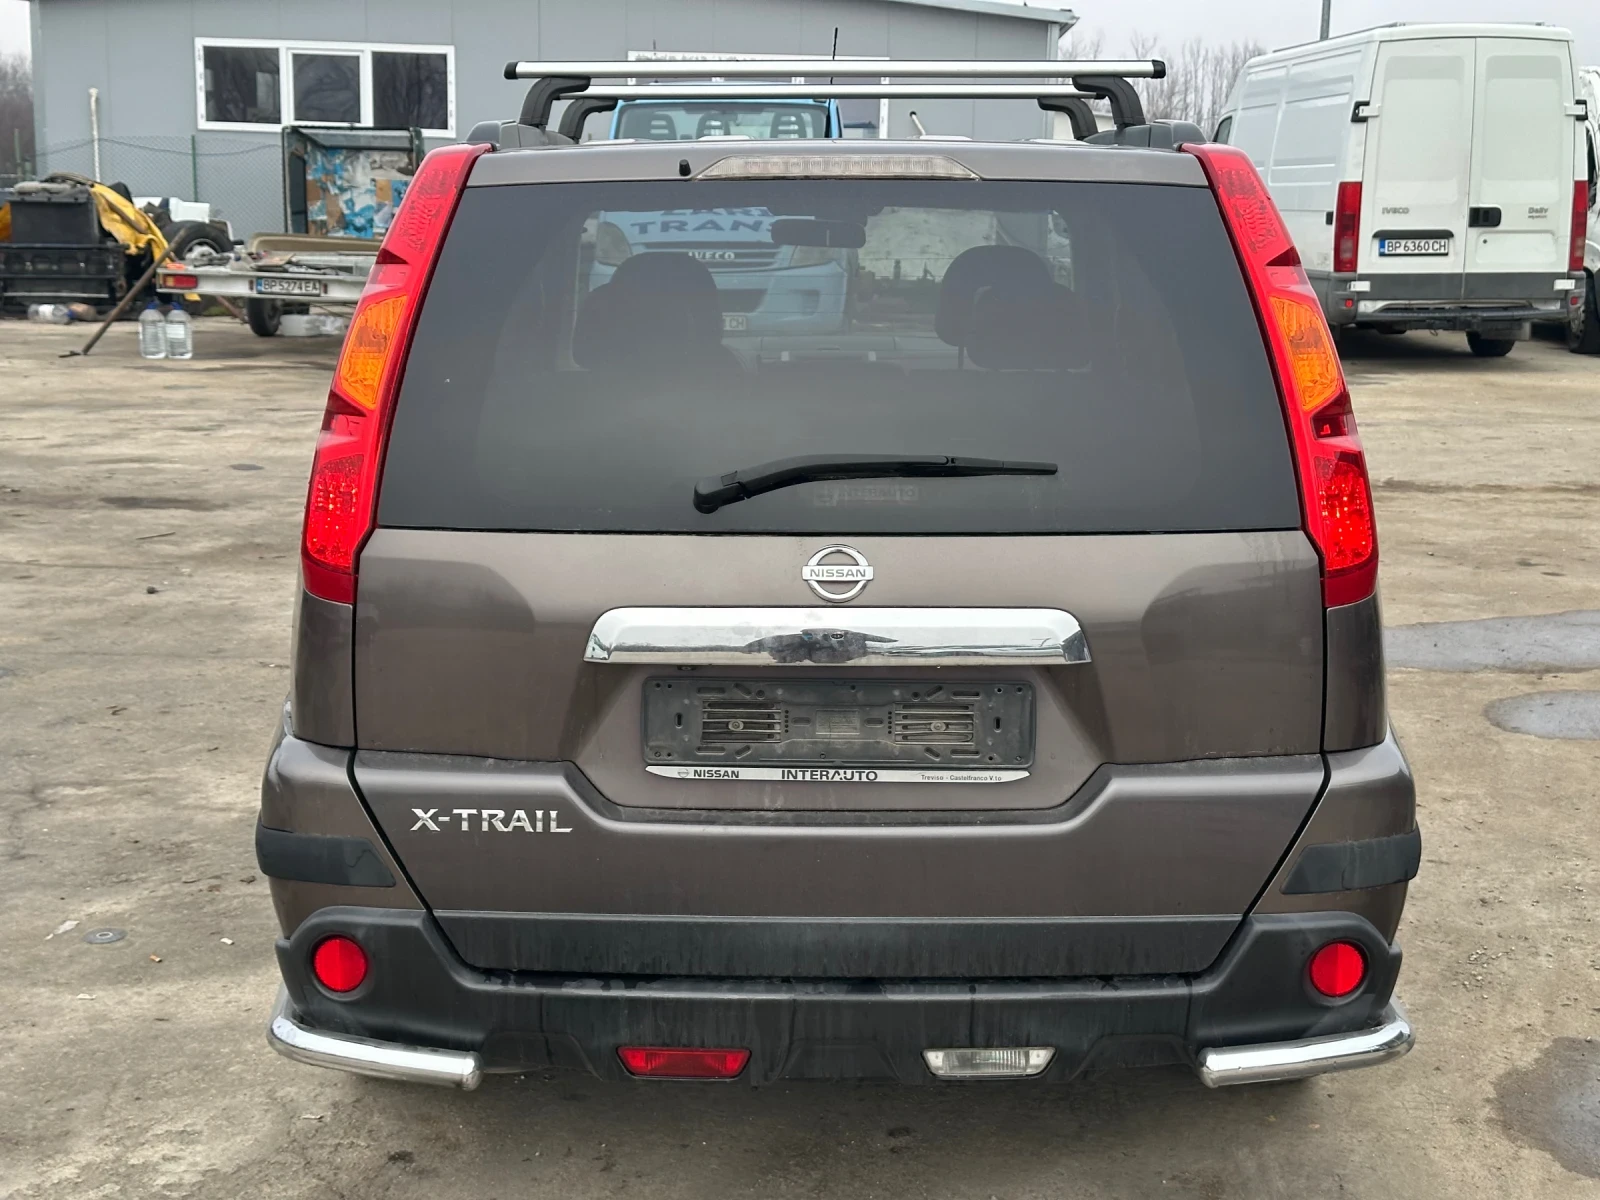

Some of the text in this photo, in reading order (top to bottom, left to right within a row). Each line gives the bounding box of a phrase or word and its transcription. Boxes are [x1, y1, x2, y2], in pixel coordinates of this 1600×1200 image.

[1382, 207, 1410, 215] IVECO
[1527, 206, 1549, 215] Daily
[630, 219, 771, 235] TRAN
[1387, 241, 1446, 252] BP 6360 CH
[263, 279, 319, 292] BP 5274 EA
[729, 317, 745, 329] CH
[809, 568, 866, 578] NISSAN
[693, 769, 740, 779] NISSAN
[781, 769, 879, 782] INTERAUTO
[949, 774, 988, 782] Castelfranco
[409, 808, 574, 833] X-TRAIL
